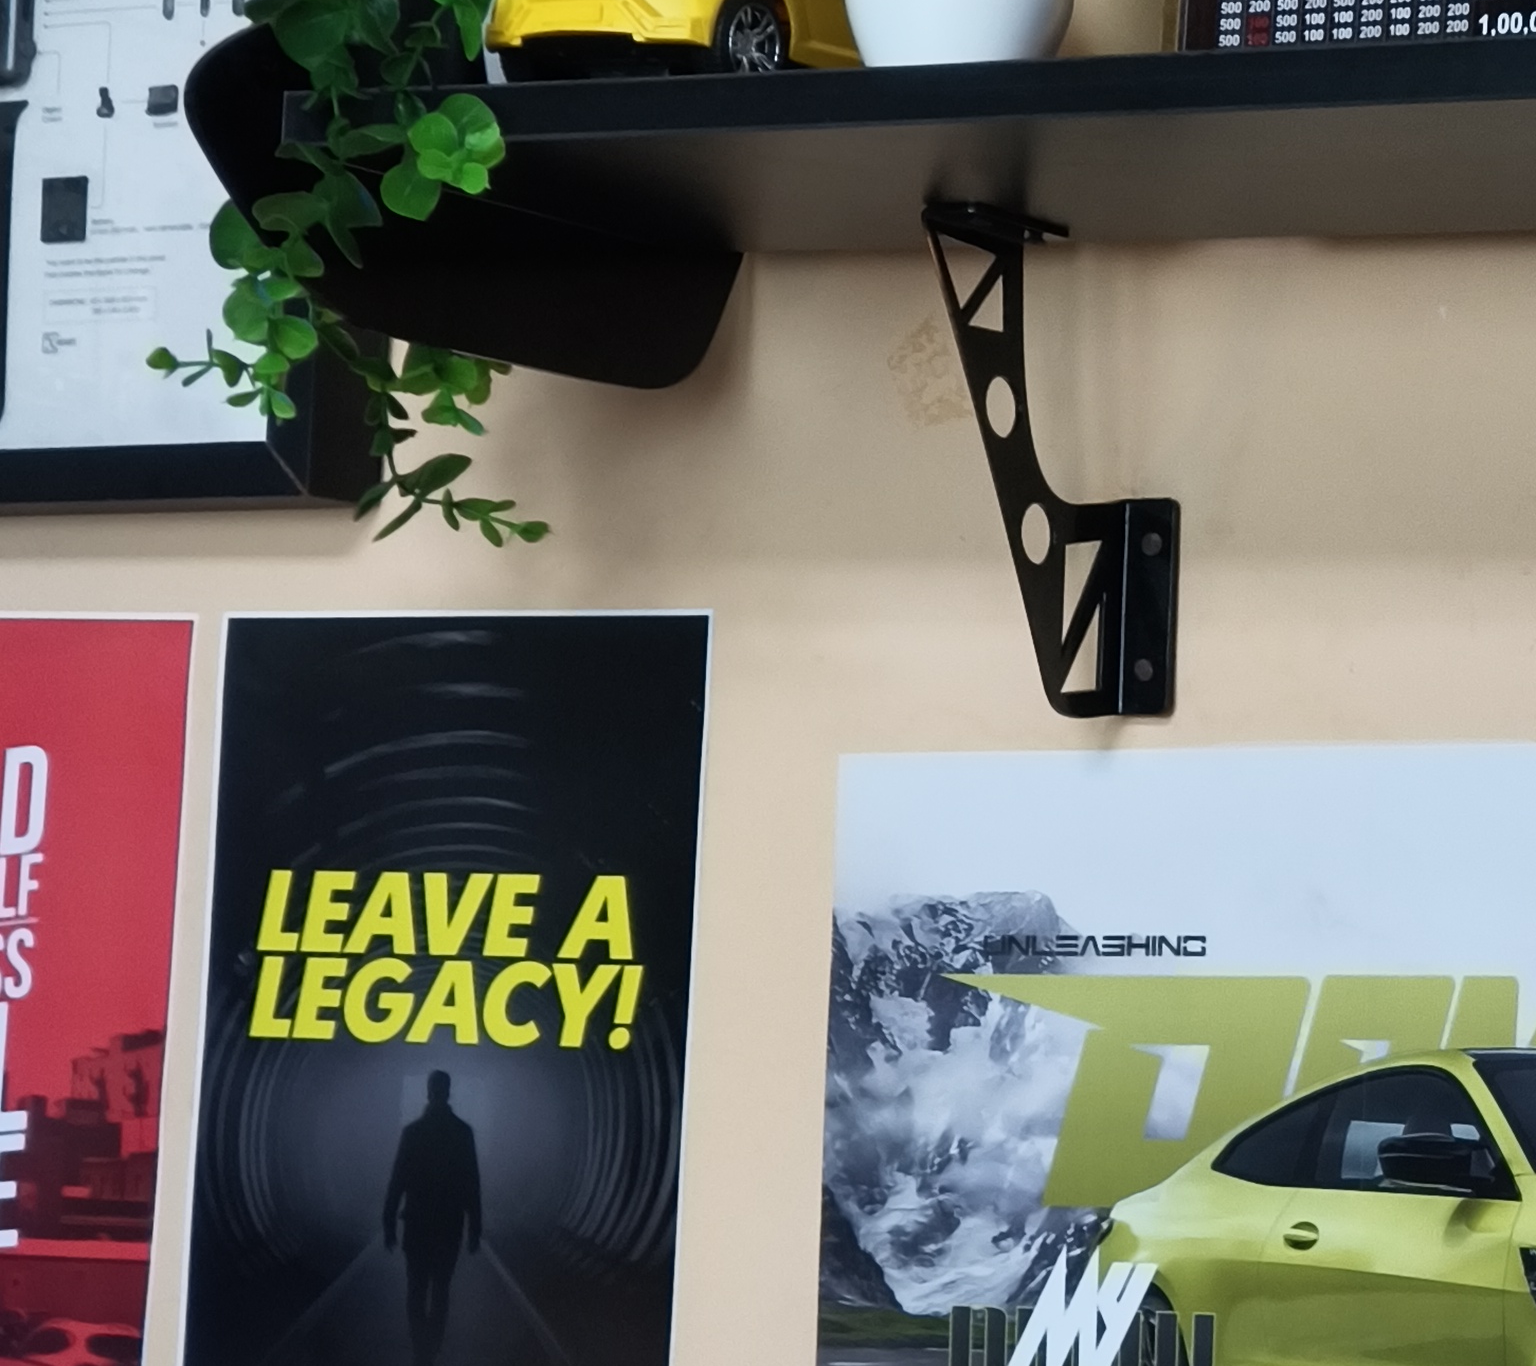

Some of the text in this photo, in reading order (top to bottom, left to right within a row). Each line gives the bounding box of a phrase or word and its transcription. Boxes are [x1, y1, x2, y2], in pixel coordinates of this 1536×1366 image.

[1220, 1, 1243, 15] 500
[1248, 0, 1271, 13] 200
[256, 869, 634, 961] LEAVE A
[983, 935, 1207, 957] UNLEASHING
[249, 956, 645, 1051] LEGACY!
